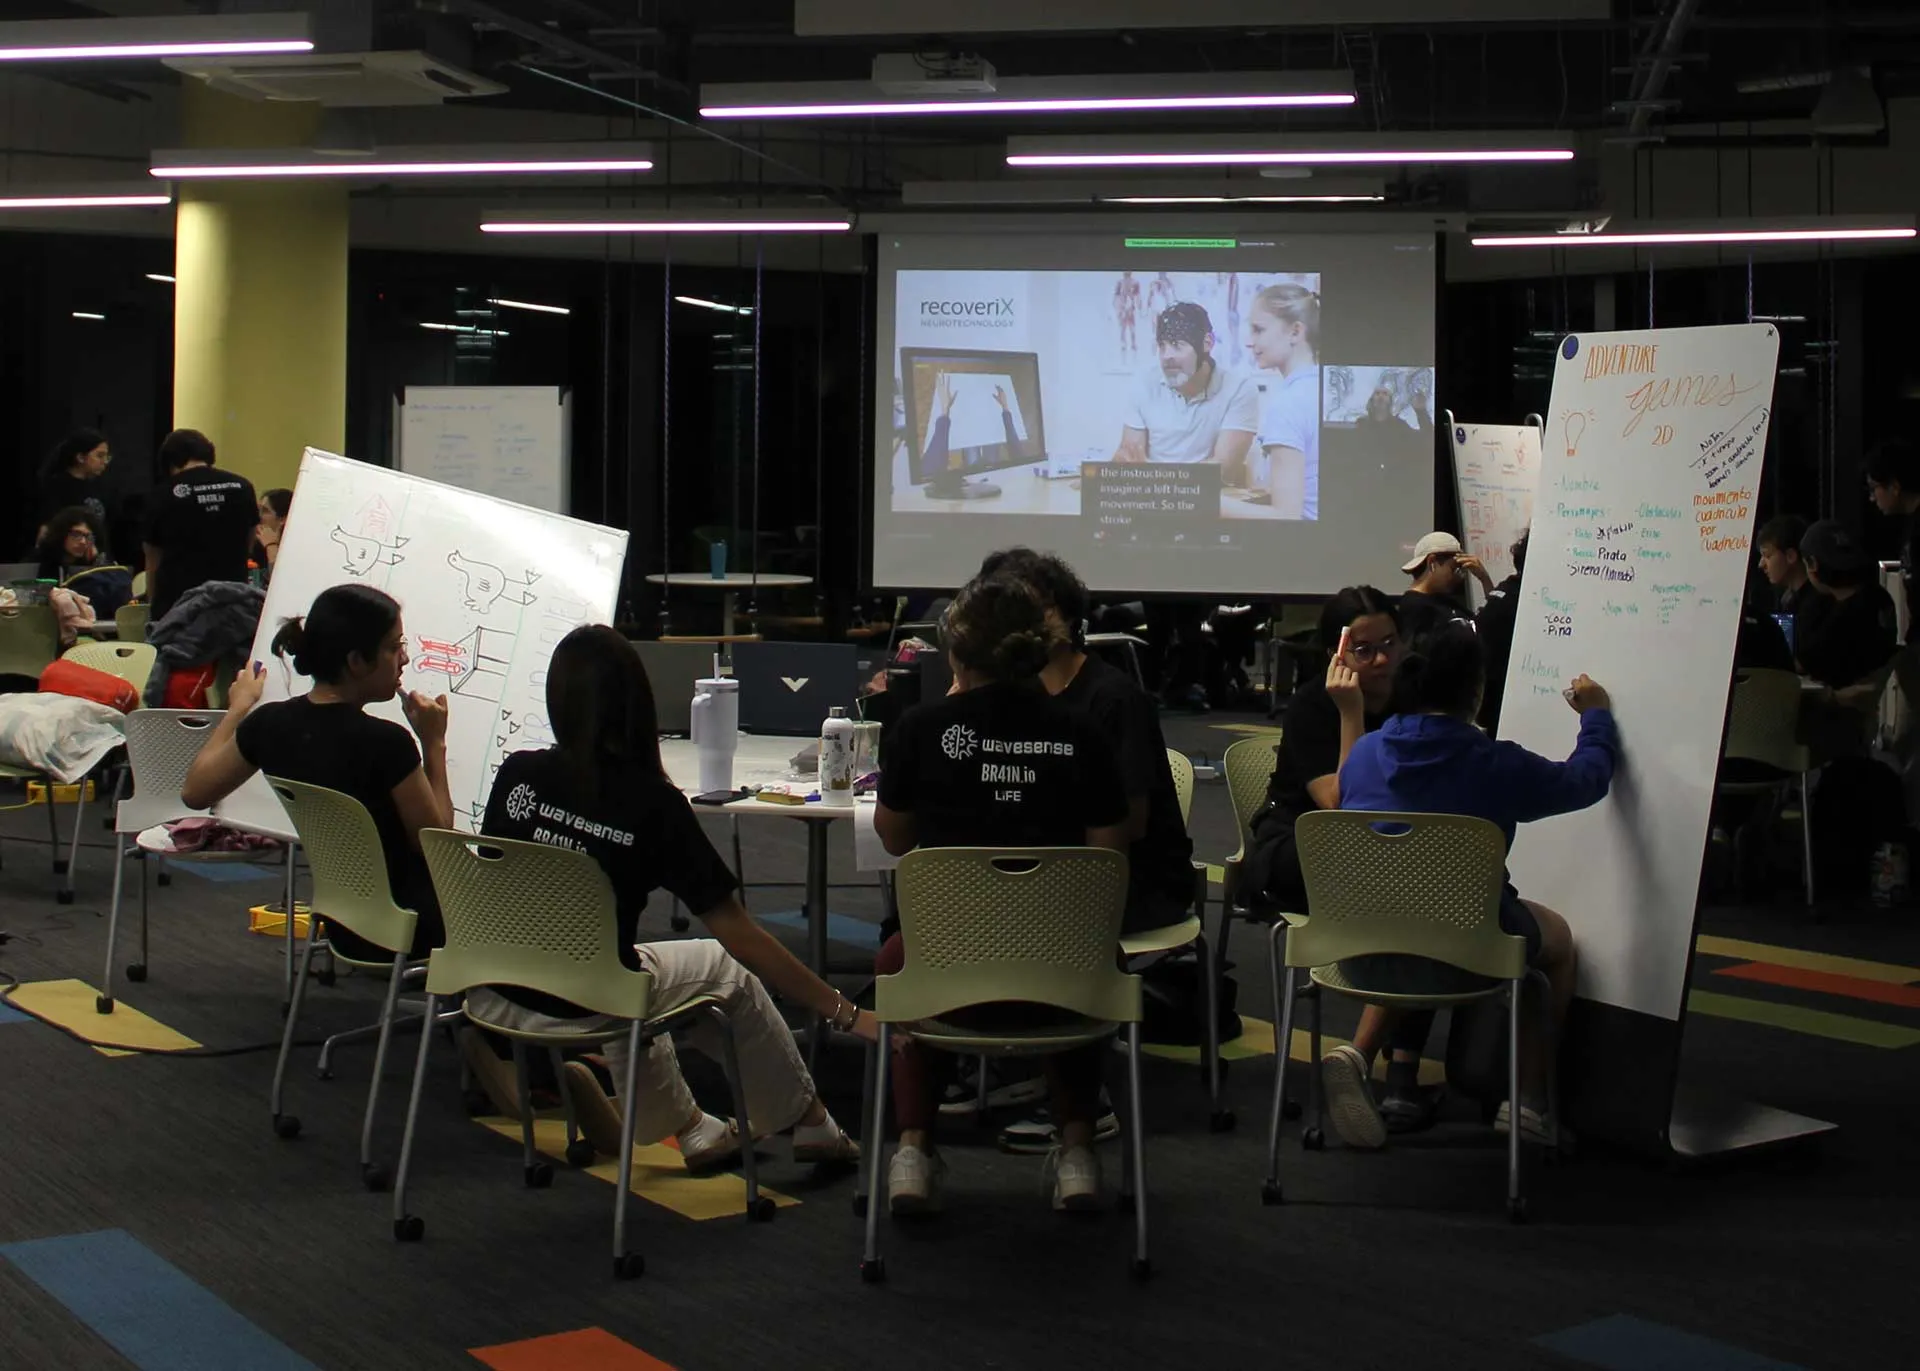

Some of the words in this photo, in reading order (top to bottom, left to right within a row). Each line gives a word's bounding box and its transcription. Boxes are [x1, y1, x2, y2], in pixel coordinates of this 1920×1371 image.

[920, 298, 1014, 316] recoveriX
[920, 318, 1015, 328] NEUROTECHNOLOGY
[1584, 344, 1660, 382] ADVENTURE
[1623, 372, 1762, 438] games
[1652, 424, 1675, 446] 2D
[1100, 467, 1118, 478] the
[1120, 467, 1175, 479] instruction
[1178, 469, 1190, 479] to
[1100, 483, 1140, 495] imagine
[1144, 486, 1151, 494] a
[1173, 484, 1200, 495] hand
[1161, 499, 1175, 510] So
[1177, 499, 1195, 510] the
[1100, 515, 1132, 525] stroke
[1598, 546, 1627, 562] Pirata
[982, 738, 1074, 757] wavesense
[981, 763, 1036, 783] BR41N.io
[538, 802, 635, 847] wavesense
